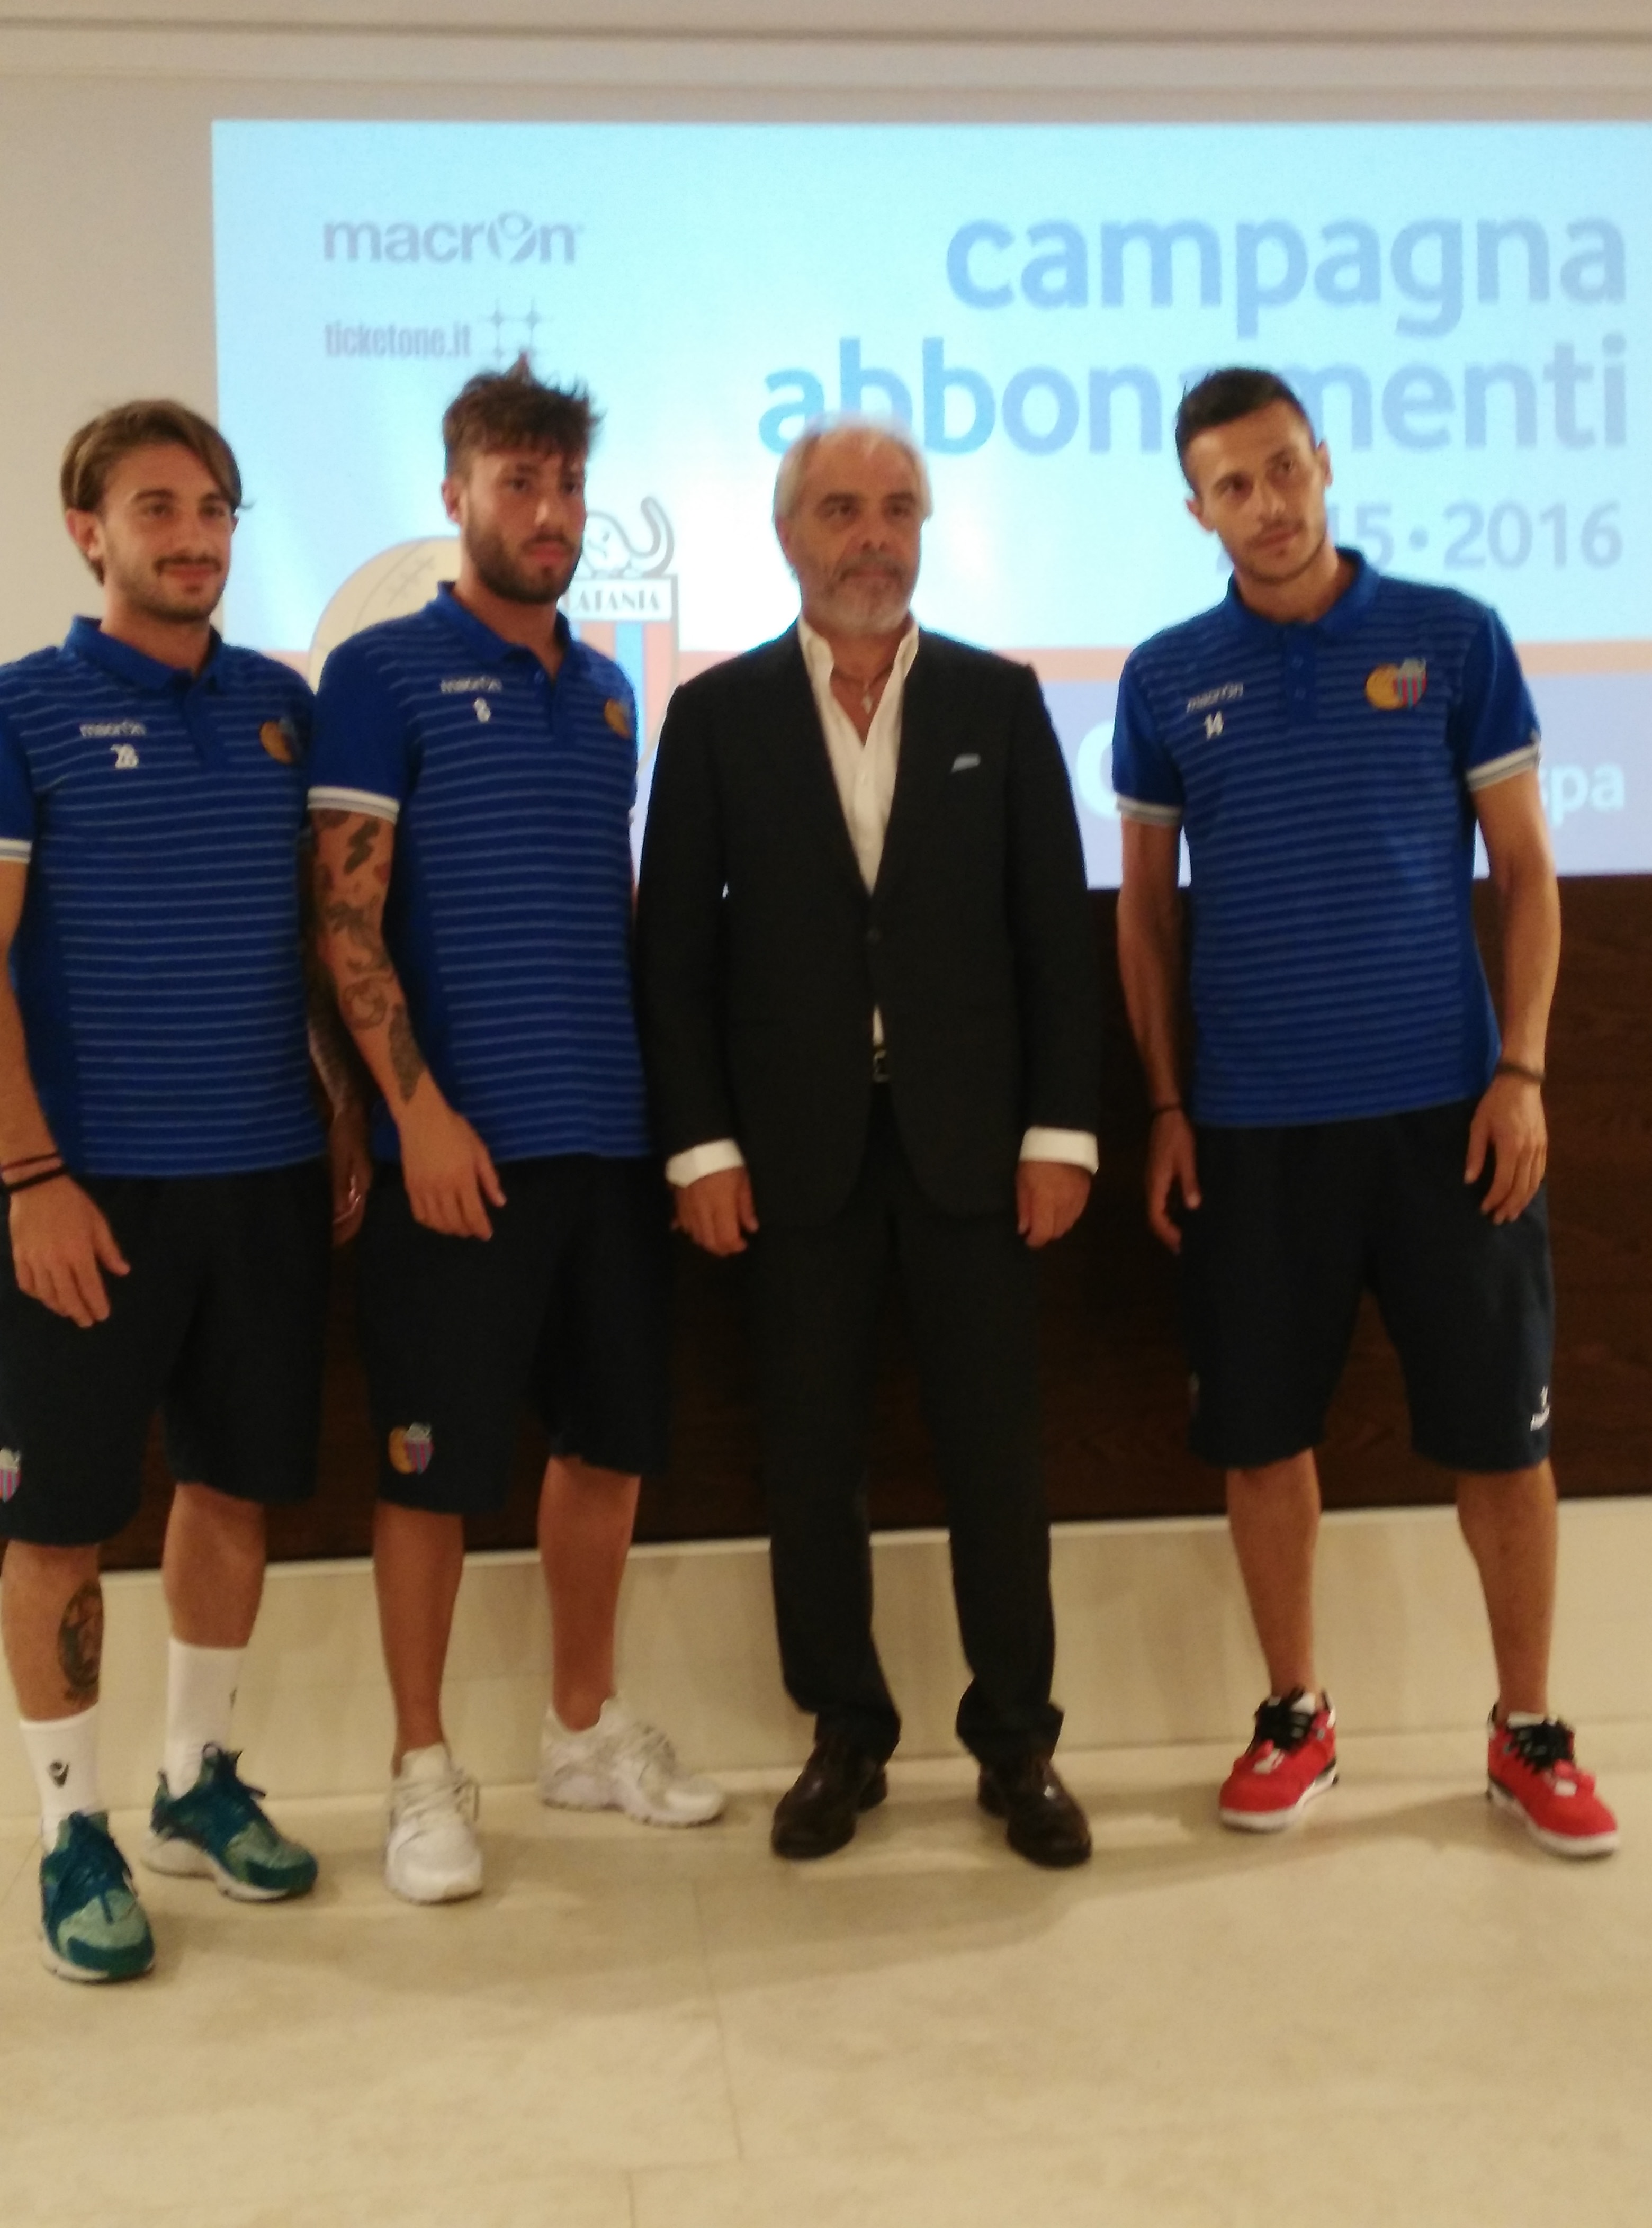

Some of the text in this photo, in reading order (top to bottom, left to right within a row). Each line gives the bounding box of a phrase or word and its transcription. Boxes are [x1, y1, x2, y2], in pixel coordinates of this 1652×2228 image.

[323, 211, 577, 264] macron
[947, 218, 1627, 340] campagna
[325, 321, 471, 358] ticketone.it
[758, 333, 1627, 455] abbonmenti
